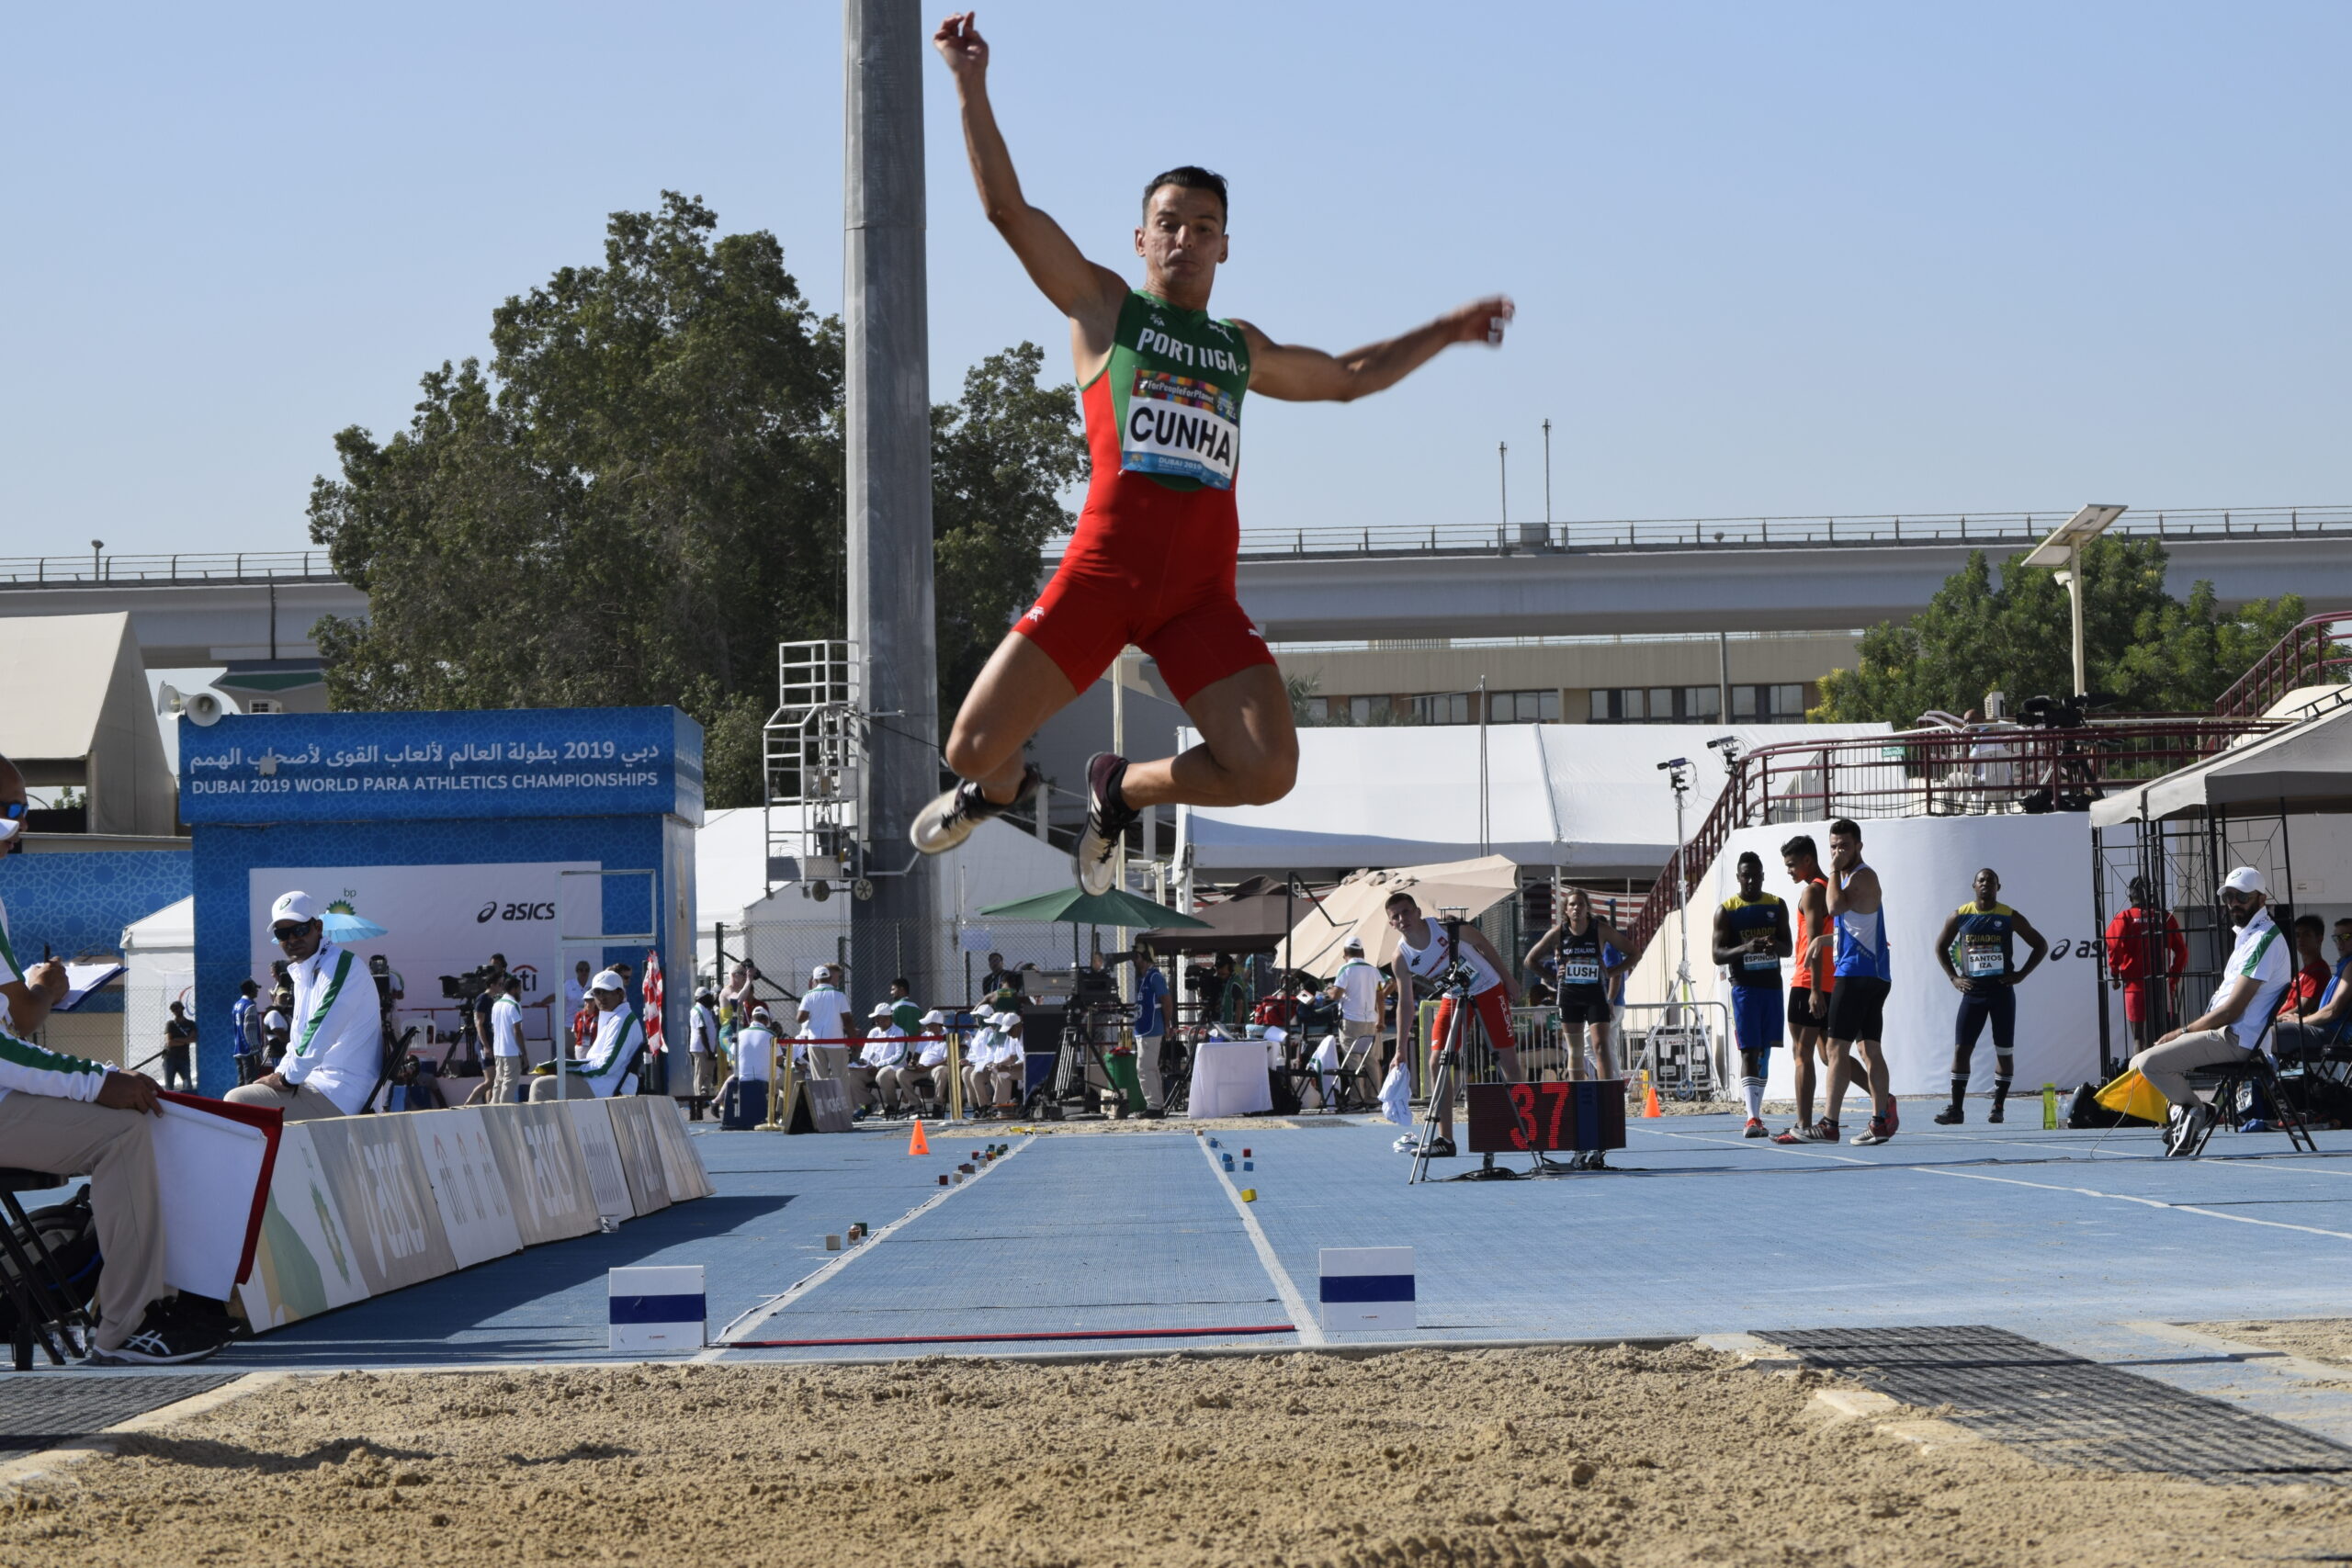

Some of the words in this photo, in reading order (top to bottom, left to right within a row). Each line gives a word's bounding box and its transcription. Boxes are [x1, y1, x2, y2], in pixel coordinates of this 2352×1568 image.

[1130, 406, 1231, 468] CUNHA
[189, 748, 242, 774] الهمم
[326, 744, 379, 767] القوى
[384, 741, 443, 768] لألعاب
[449, 743, 502, 770] العالم
[507, 741, 558, 764] بطولة
[563, 741, 616, 759] 2019
[620, 744, 660, 768] دبي
[192, 780, 245, 795] DUBAI
[250, 779, 290, 794] 2019
[294, 778, 358, 793] WORLD
[363, 777, 409, 792] PARA
[413, 774, 507, 791] ATHLETICS
[511, 772, 658, 788] CHAMPIONSHIPS
[344, 887, 356, 899] bp
[502, 902, 555, 920] asics
[1965, 934, 2002, 942] ECUADOR
[1969, 954, 2003, 963] SANTOS
[1566, 966, 1598, 978] LUSH
[1498, 995, 1514, 1038] POLSKA
[1510, 1082, 1570, 1150] 37
